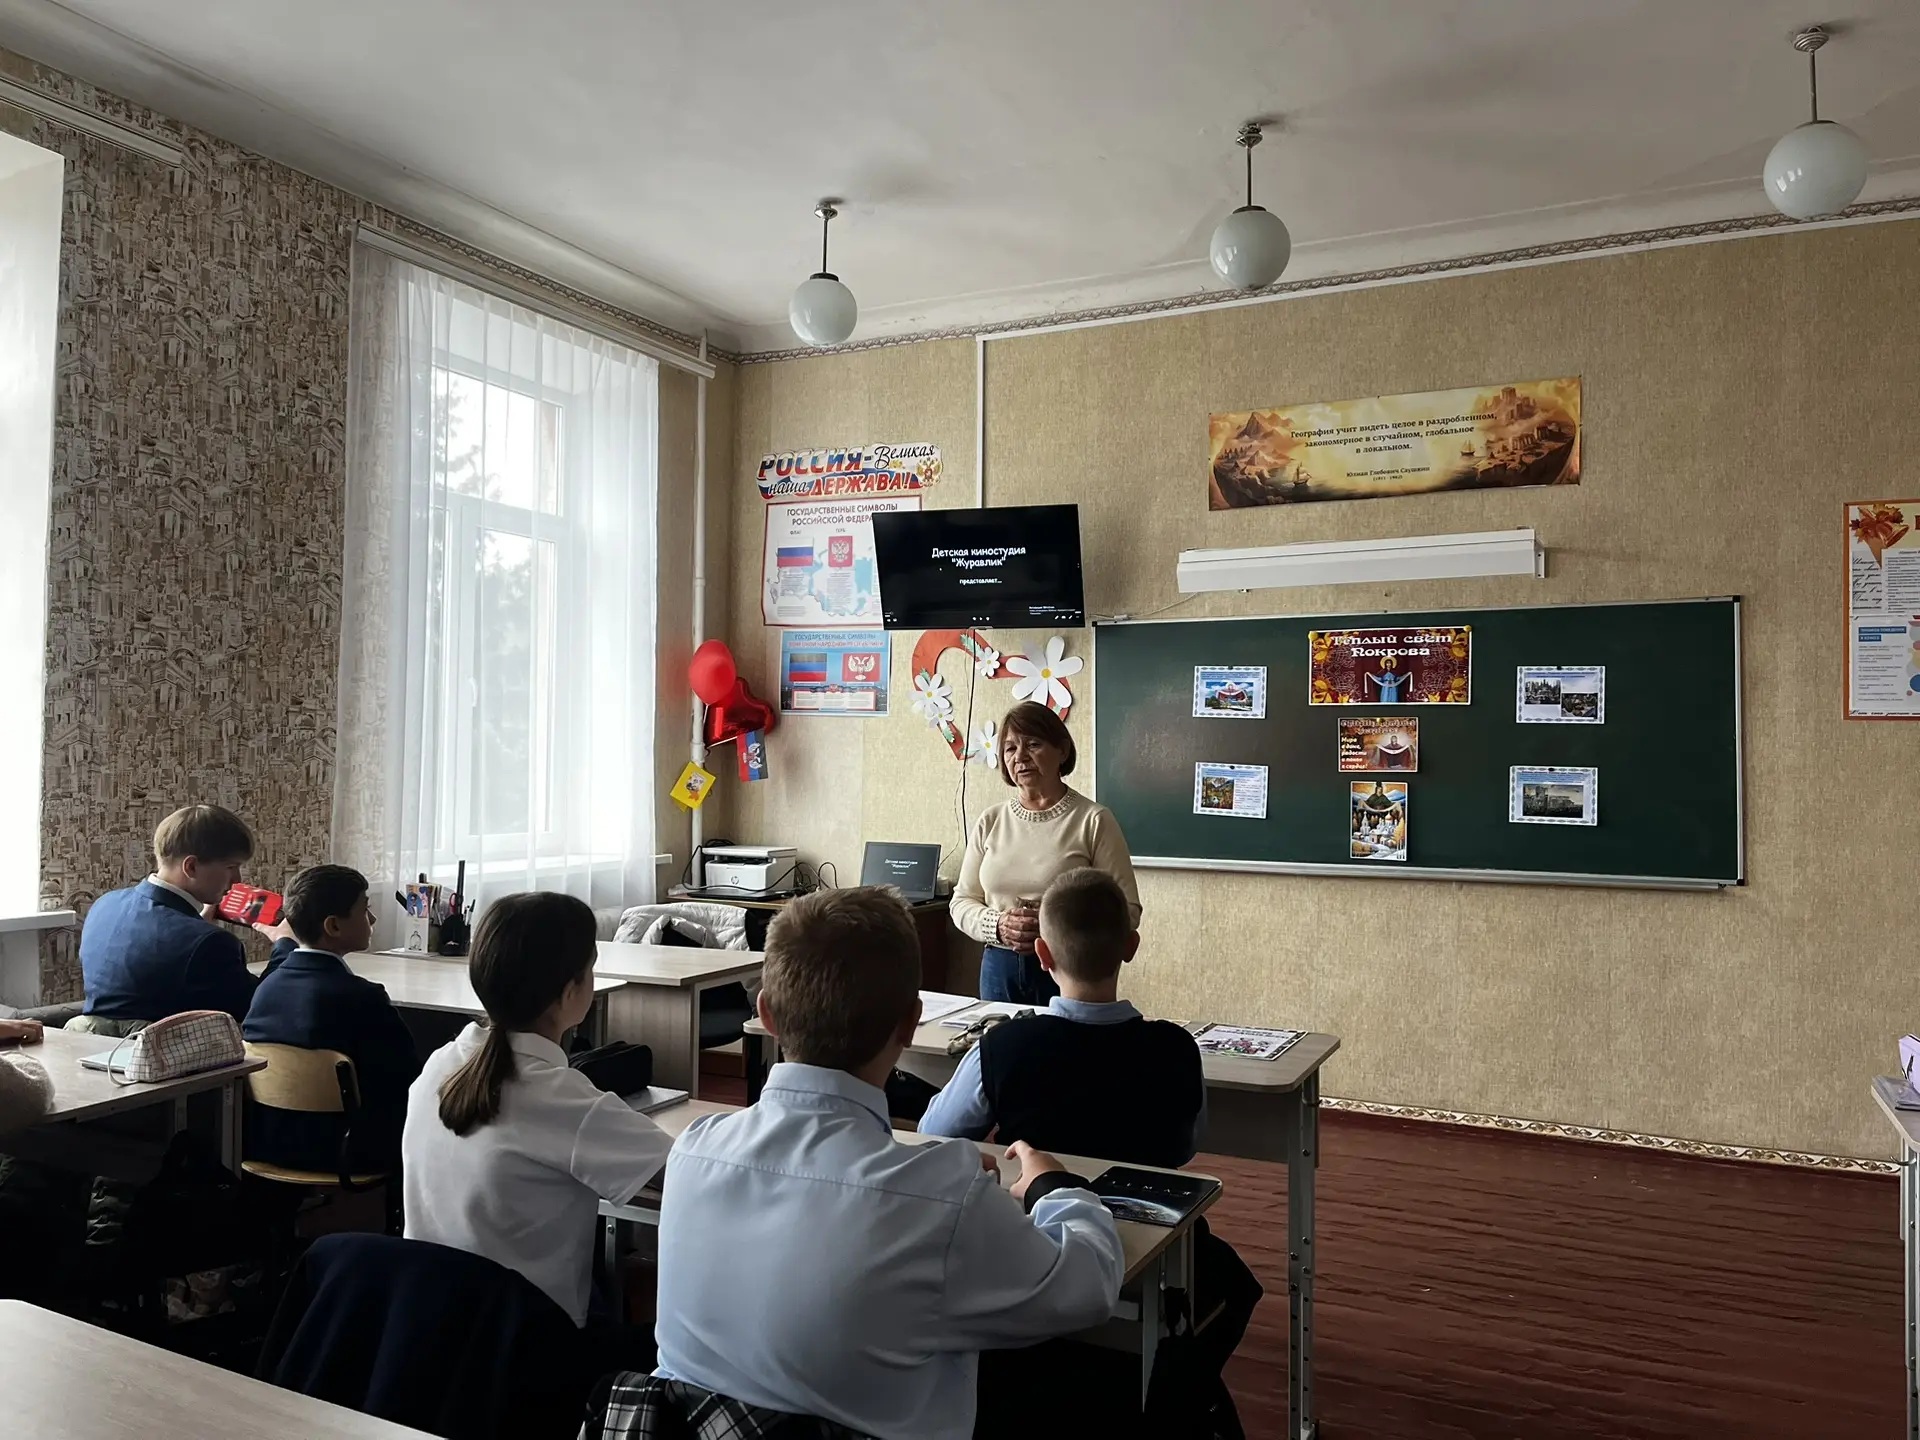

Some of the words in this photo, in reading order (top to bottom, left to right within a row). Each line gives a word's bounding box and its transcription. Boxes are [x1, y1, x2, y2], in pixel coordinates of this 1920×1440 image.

[1290, 429, 1334, 438] География
[1336, 426, 1357, 435] учит
[1359, 423, 1390, 432] видеть
[1391, 420, 1416, 429] целое
[1426, 412, 1497, 427] раздробленном,
[1304, 436, 1364, 448] закономерное
[1372, 430, 1424, 442] случайном,
[1425, 426, 1475, 437] глобальное
[1363, 442, 1412, 453] локальном.
[874, 444, 935, 470] Великая
[768, 481, 810, 496] наша
[809, 471, 912, 496] ДЕРЖАВА!
[787, 505, 855, 517] ГОСУДАРСТВЕННЫЕ
[856, 503, 898, 512] СИМВОЛЫ
[792, 515, 844, 526] РОССИЙСКОЙ
[931, 547, 969, 559] Детская
[970, 546, 1027, 561] киностудия
[951, 557, 1006, 570] "Журавлик"
[794, 632, 847, 641] ГОСУДАРСТВЕННЫЕ
[847, 632, 877, 640] СИМВОЛЫ
[1403, 634, 1453, 644] свет
[1351, 647, 1430, 658] Покрова
